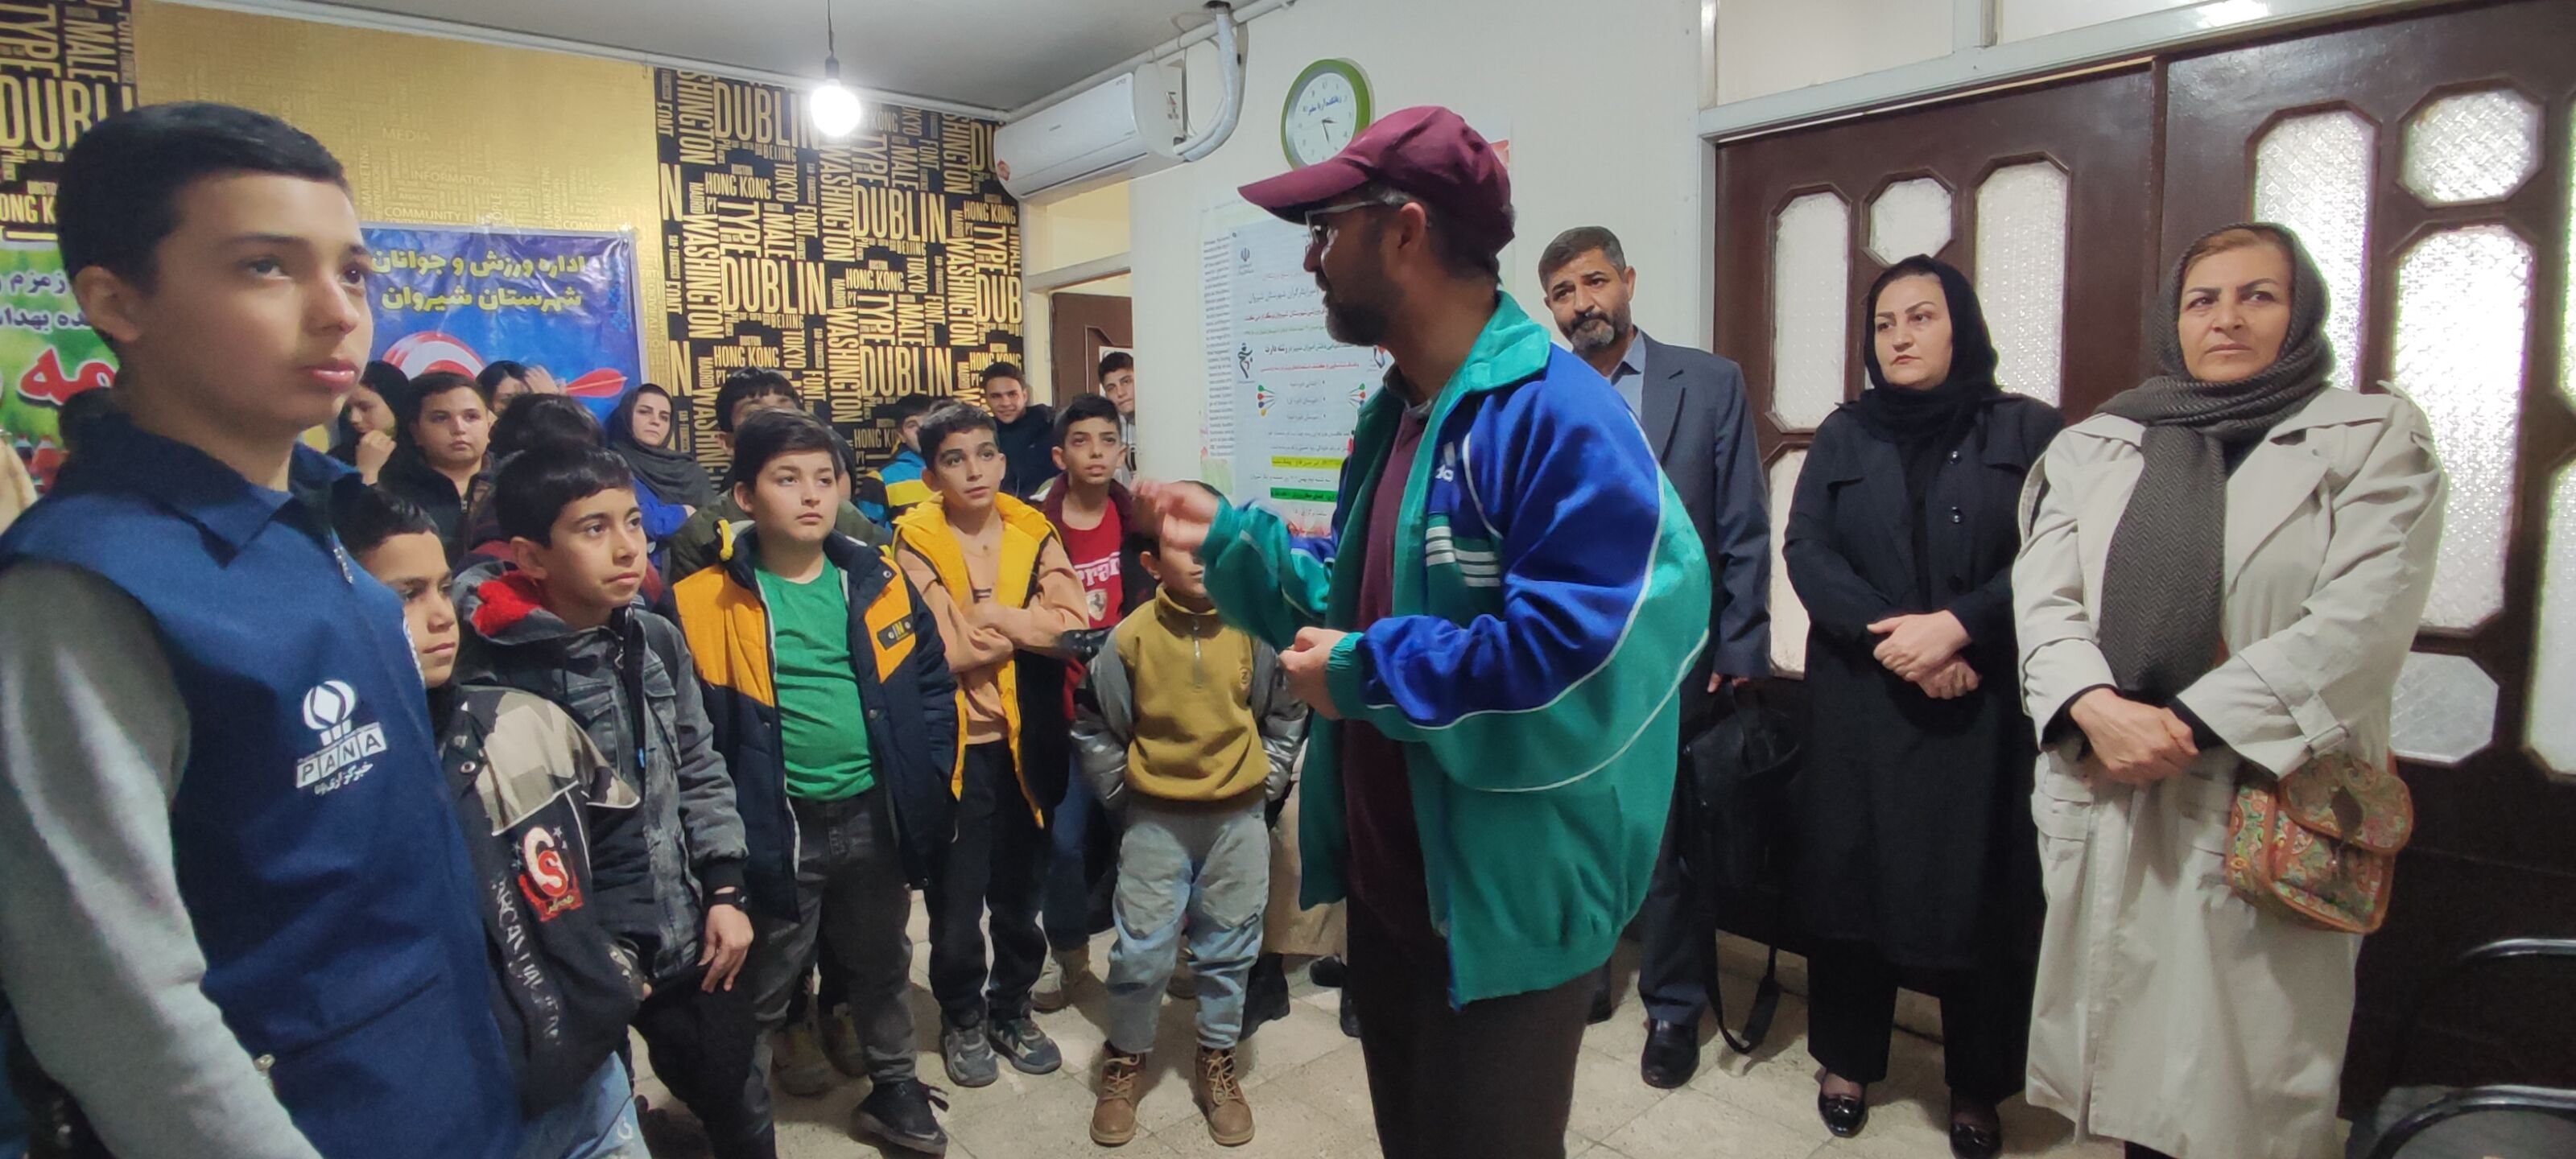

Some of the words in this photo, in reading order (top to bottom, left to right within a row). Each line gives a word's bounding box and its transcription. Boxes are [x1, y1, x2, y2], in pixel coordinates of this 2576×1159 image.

[0, 4, 61, 78] TYPE
[63, 19, 118, 83] MALE
[382, 127, 431, 142] MEDIA
[902, 106, 923, 137] KYO
[763, 143, 797, 163] BEIJING
[851, 133, 889, 188] TYPE
[890, 144, 919, 191] MALE
[919, 138, 940, 171] FONT
[411, 171, 494, 187] INFORMATION
[705, 171, 737, 197] HONG
[739, 175, 772, 200] KONG
[774, 163, 799, 203] TOKYO
[384, 206, 462, 221] COMMUNITY
[819, 143, 856, 263] WASHINGTON
[852, 184, 947, 244] DUBLIN
[963, 200, 989, 221] HONG
[991, 203, 1017, 225] KONG
[718, 200, 762, 258] TYPE
[762, 212, 796, 261] MALE
[794, 204, 819, 238] FONT
[371, 250, 447, 275] جوانان
[469, 250, 534, 278] ورزش
[897, 240, 927, 256] BEIJING
[974, 225, 1008, 276] TYPE
[452, 256, 464, 274] و
[539, 255, 586, 278] اداره
[683, 213, 724, 340] WASHINGTON
[845, 268, 874, 291] HONG
[876, 270, 905, 292] KONG
[906, 257, 928, 295] TOKYO
[382, 285, 473, 312] شیروان
[478, 286, 582, 312] شهرستان
[665, 280, 683, 316] FONT
[720, 255, 828, 316] DUBLIN
[946, 236, 979, 347] WASHINGTON
[770, 313, 805, 329] BEIJING
[857, 293, 896, 346] TYPE
[897, 303, 926, 347] MALE
[923, 295, 946, 326] FONT
[713, 345, 746, 368] HONG
[748, 346, 780, 369] KONG
[782, 330, 807, 369] TOKYO
[826, 307, 864, 423] WASHINGTON
[698, 356, 716, 389] MADRID
[803, 370, 828, 402] FONT
[860, 345, 954, 398] DUBLIN
[853, 428, 882, 448] HONG
[301, 733, 382, 782] PANA
